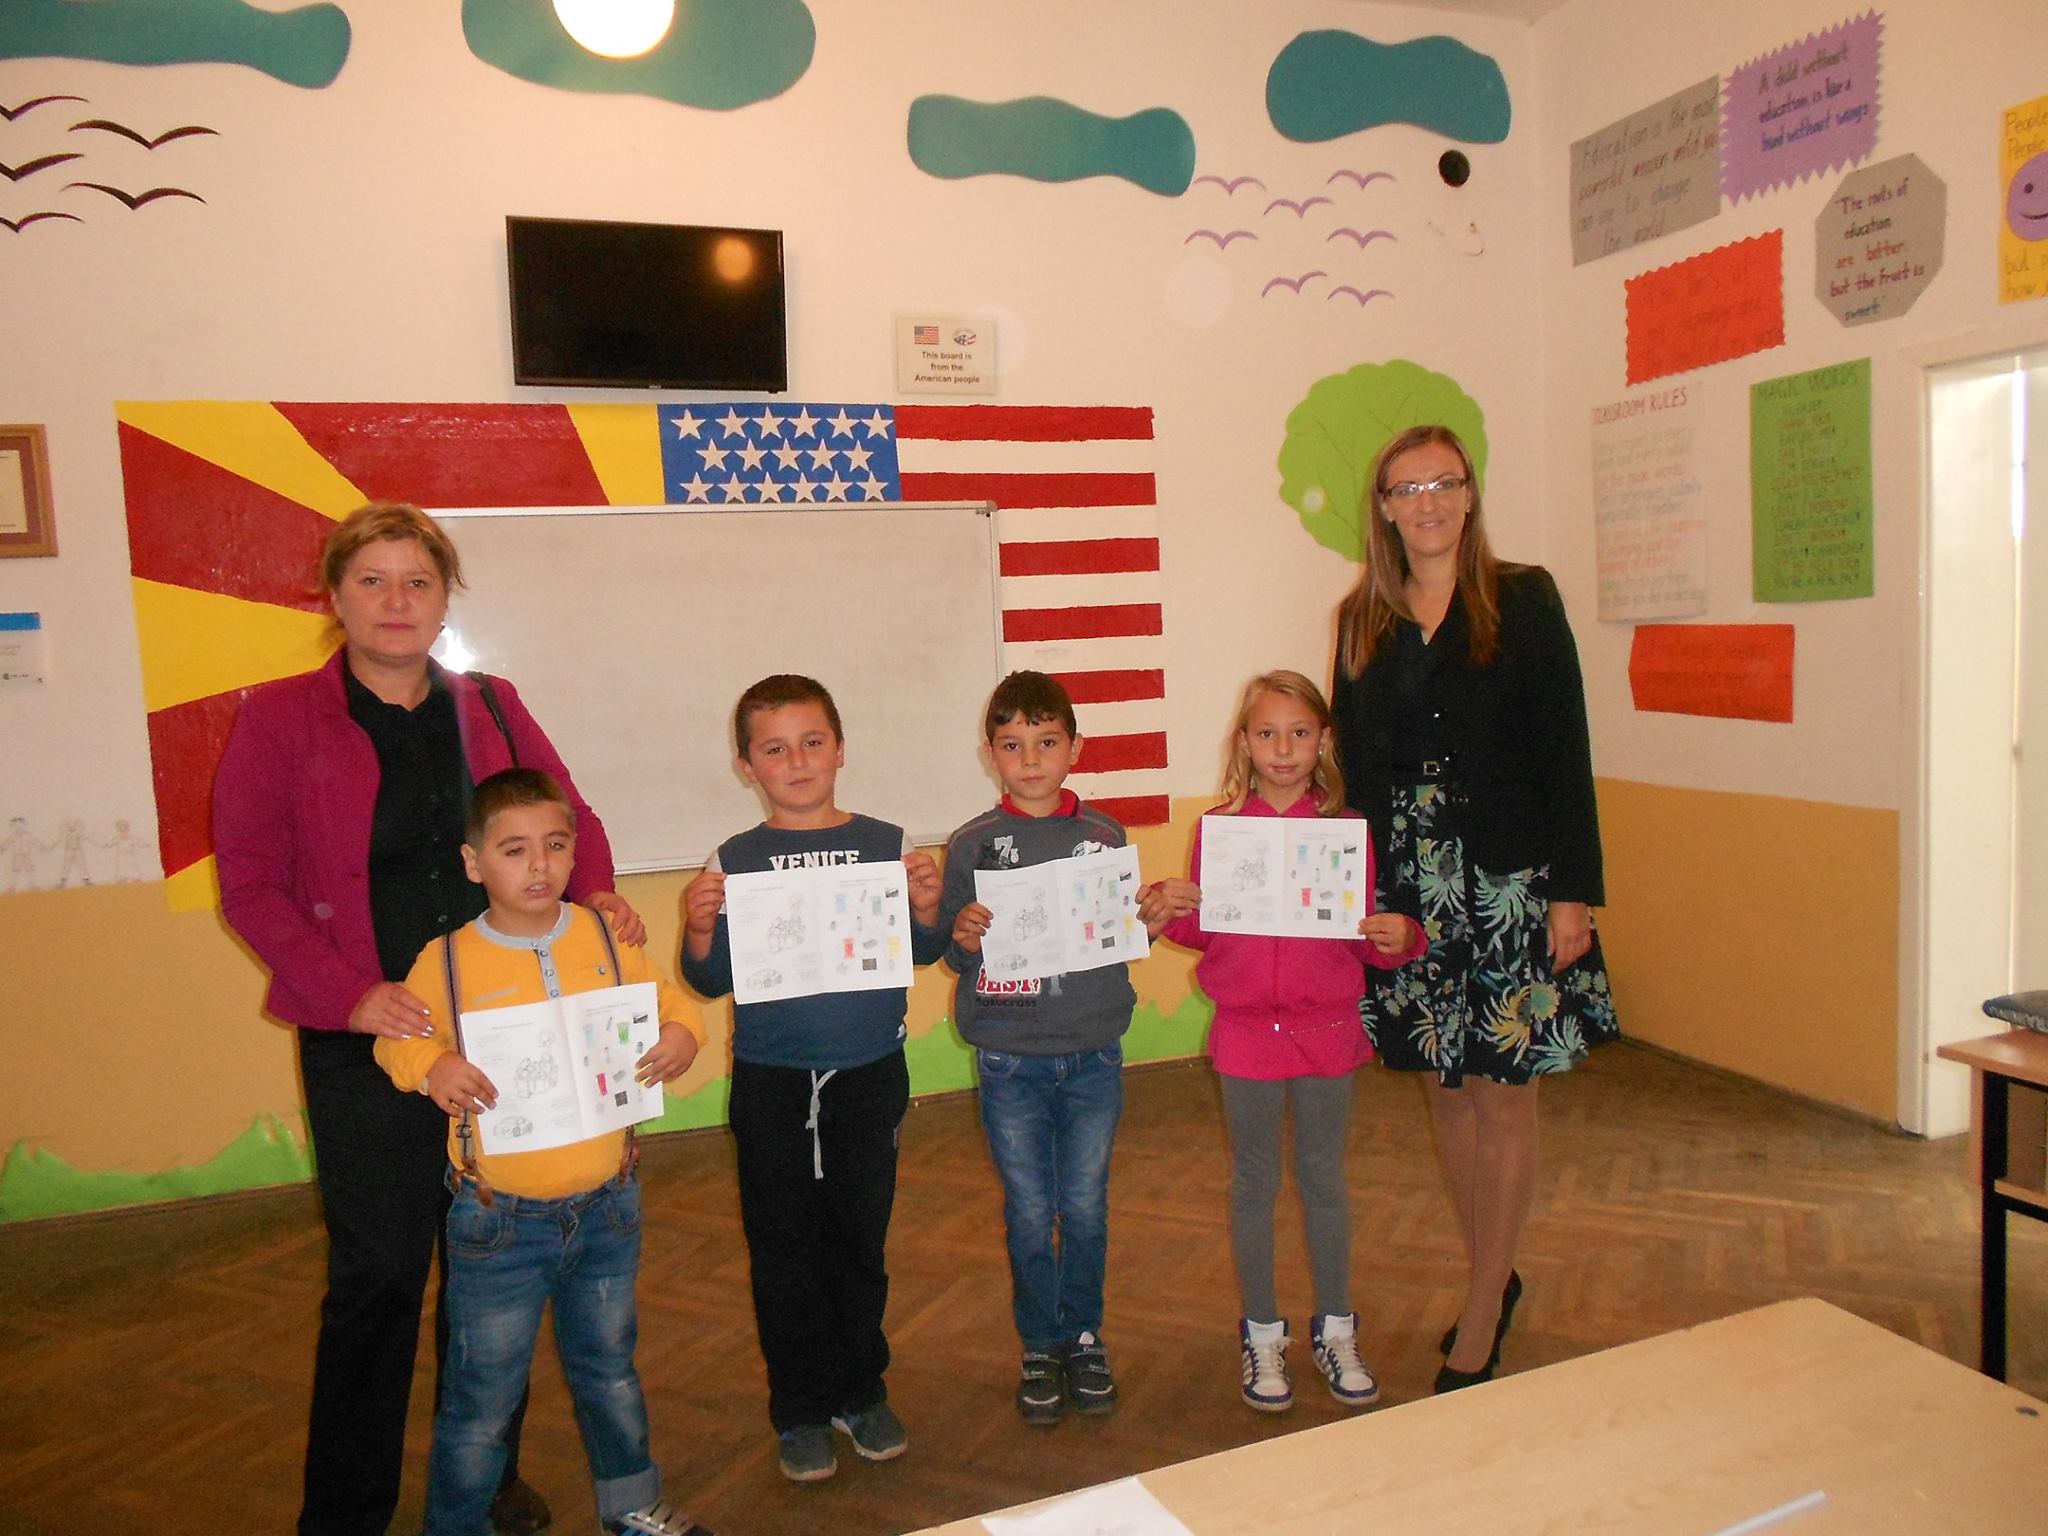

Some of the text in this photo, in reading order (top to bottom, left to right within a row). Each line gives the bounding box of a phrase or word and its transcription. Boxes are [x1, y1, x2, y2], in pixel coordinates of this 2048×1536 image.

[1830, 277, 1850, 297] but
[1855, 272, 1875, 290] the
[922, 351, 939, 360] This
[940, 351, 963, 360] board
[930, 363, 963, 371] from the
[914, 374, 980, 384] American people
[1650, 387, 1687, 411] RULES
[769, 849, 860, 871] VENICE
